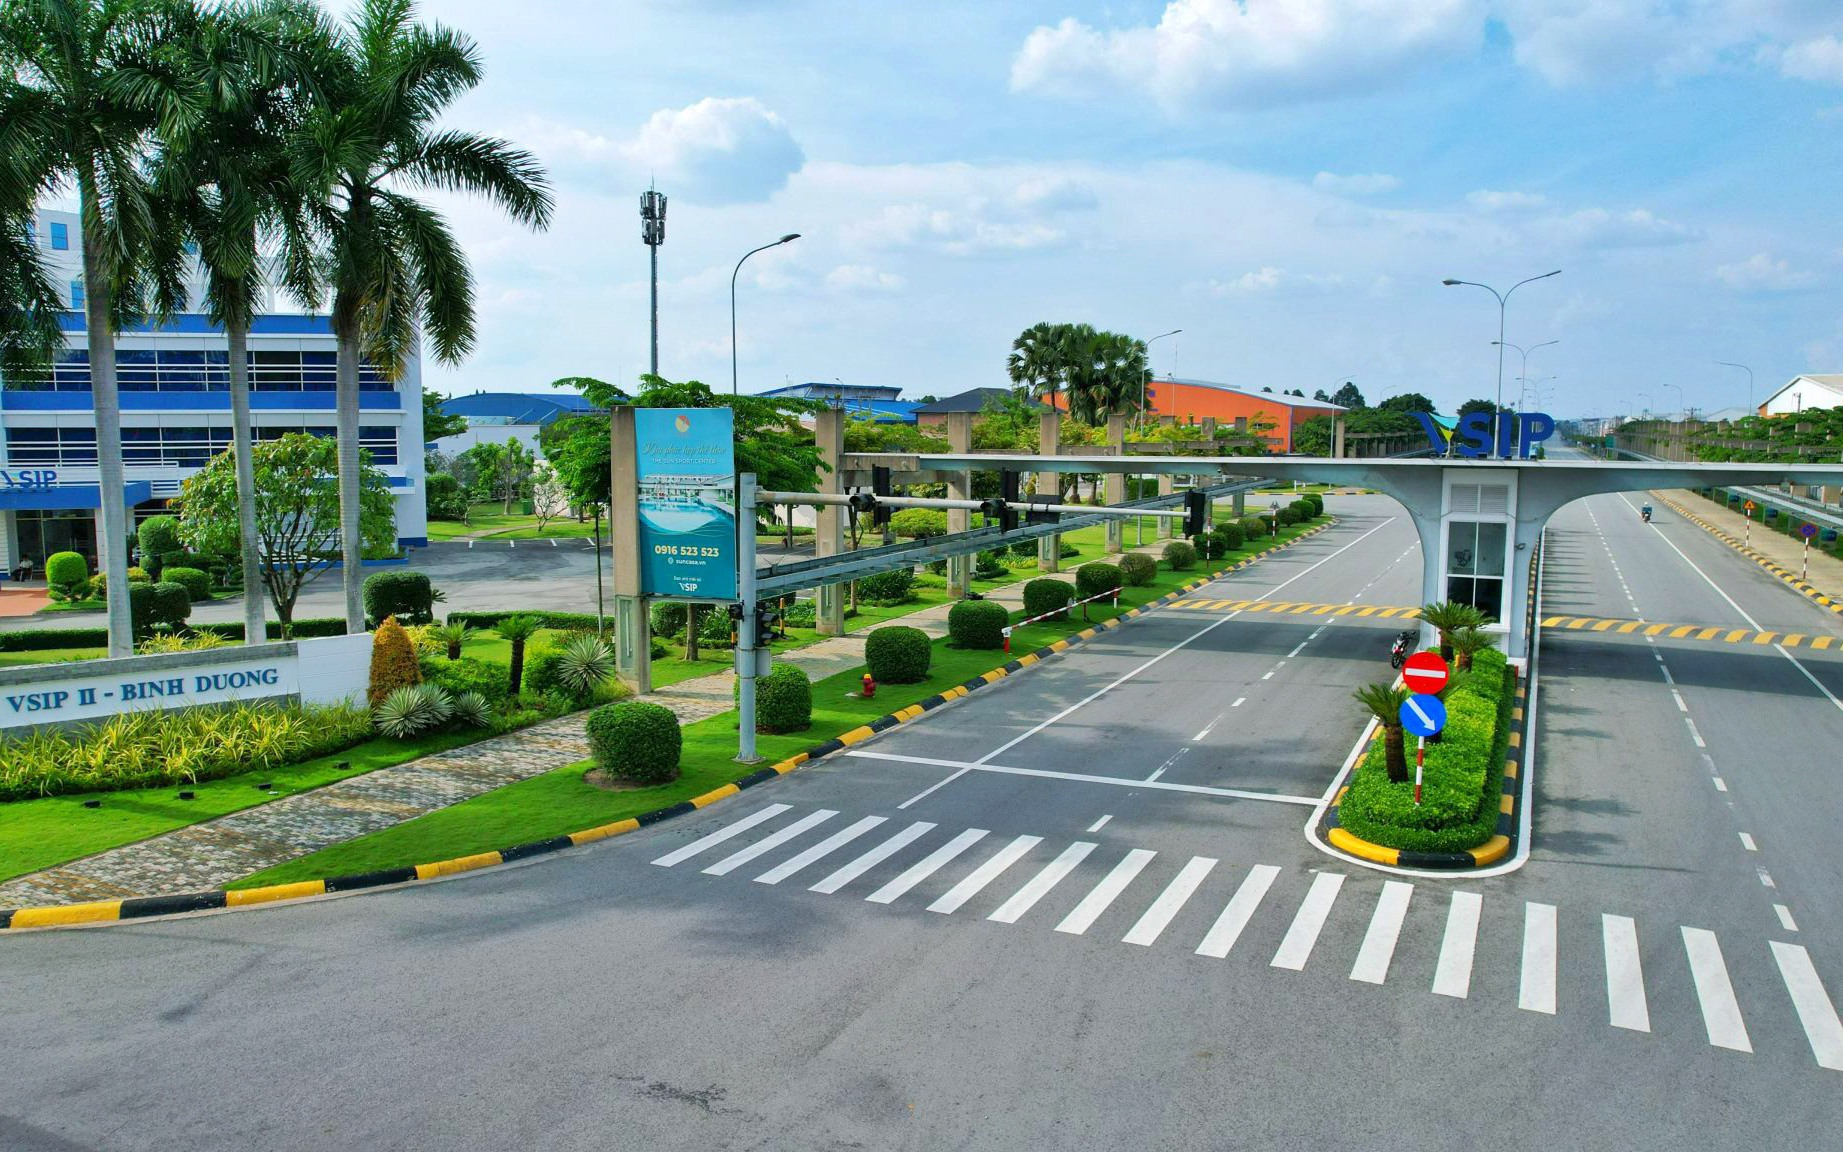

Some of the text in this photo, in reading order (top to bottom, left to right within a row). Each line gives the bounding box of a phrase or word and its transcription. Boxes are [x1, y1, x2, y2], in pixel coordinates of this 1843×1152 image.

[1405, 411, 1555, 460] VSIP
[654, 545, 719, 557] 0916 523 523
[678, 582, 698, 592] VSIP
[6, 690, 69, 713] VSIP
[78, 687, 98, 706] II
[121, 677, 185, 701] BINH
[195, 668, 279, 693] DUONG
